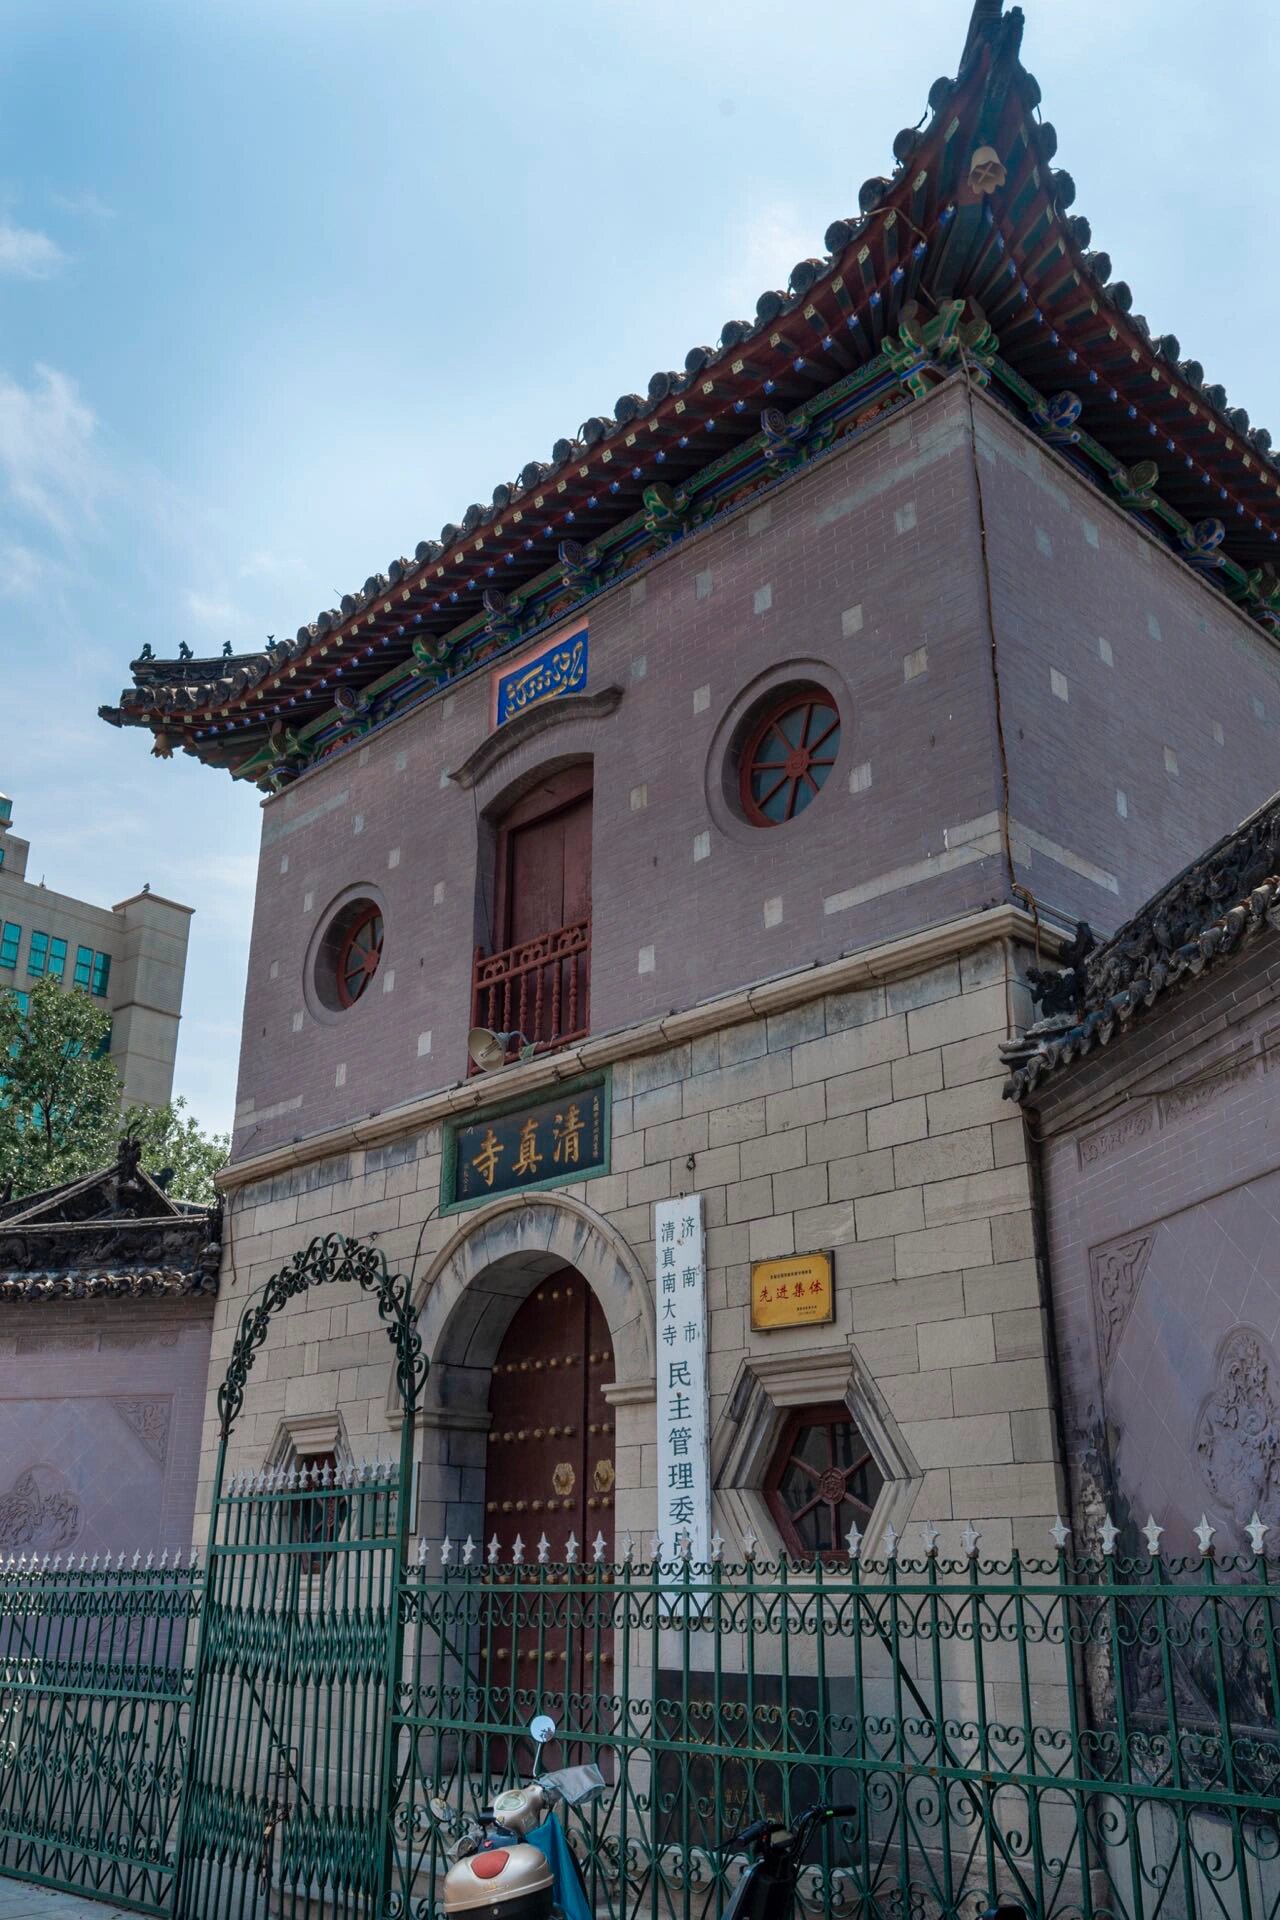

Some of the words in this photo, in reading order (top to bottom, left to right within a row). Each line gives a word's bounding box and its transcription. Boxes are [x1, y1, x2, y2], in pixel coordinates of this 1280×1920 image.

[472, 1103, 586, 1187] 清真寺
[661, 1221, 678, 1347] 清真南大寺
[681, 1216, 698, 1343] 济南市
[759, 1279, 824, 1303] 先进集体
